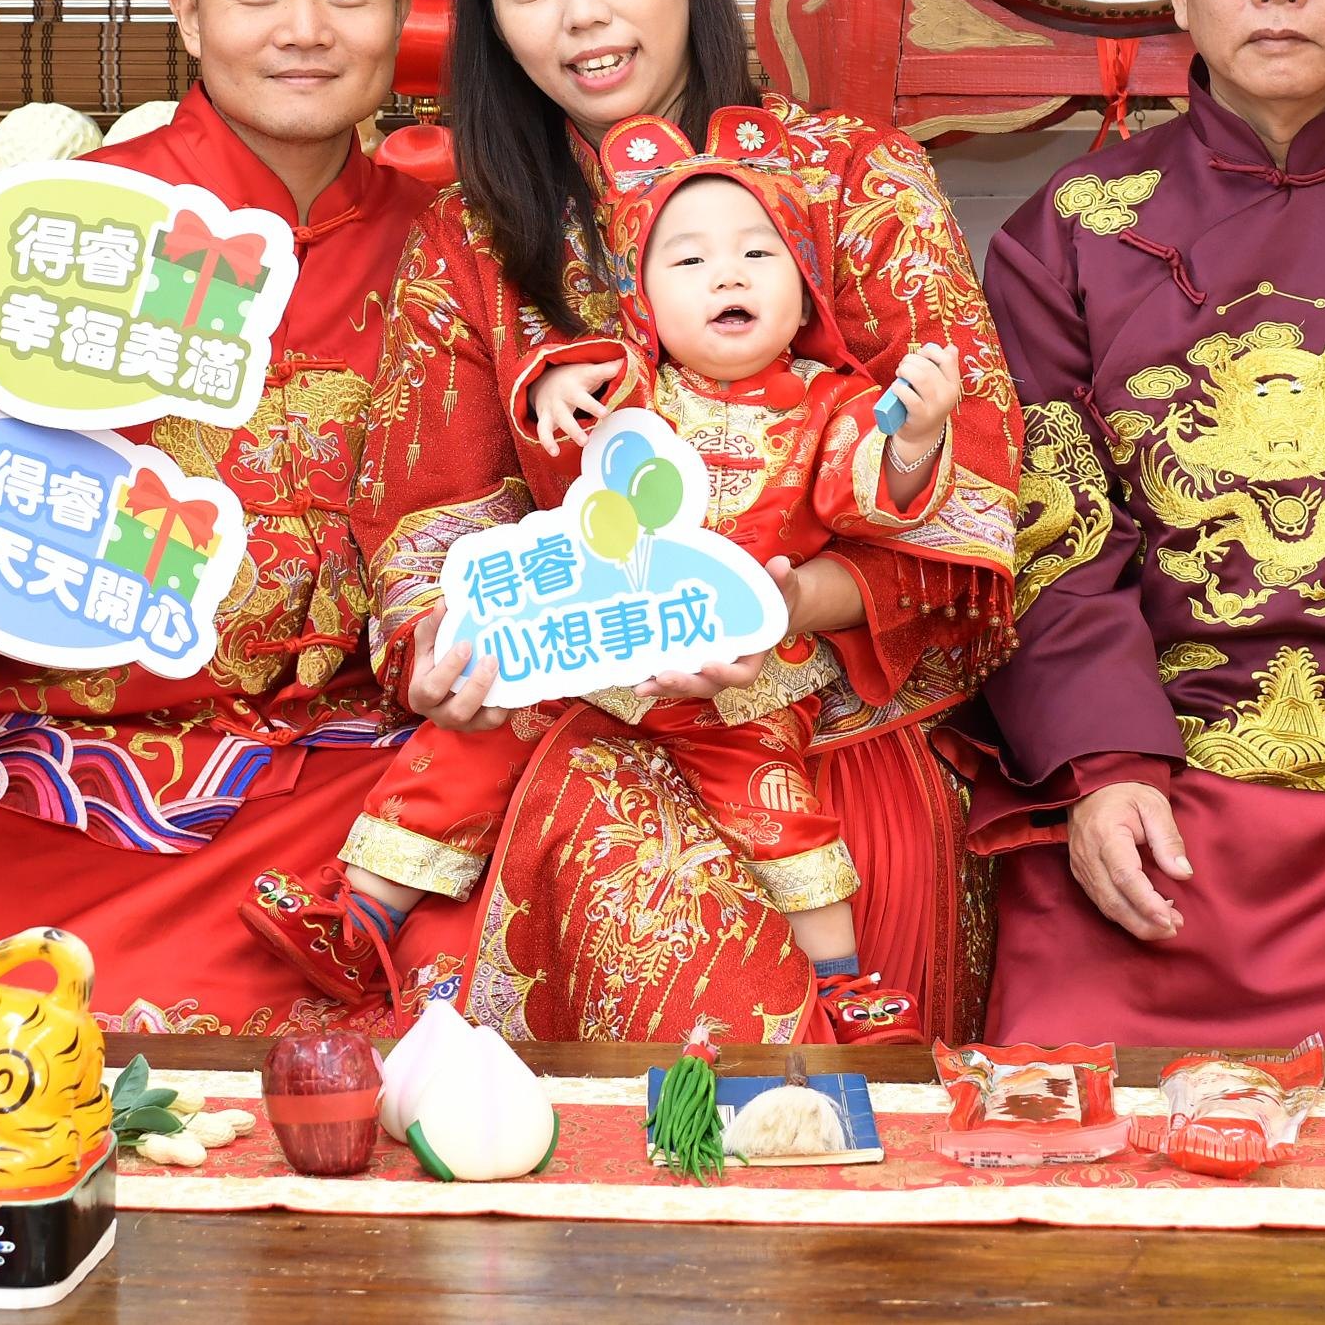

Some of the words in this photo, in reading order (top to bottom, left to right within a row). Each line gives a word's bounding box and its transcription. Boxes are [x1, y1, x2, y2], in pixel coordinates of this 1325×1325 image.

[13, 214, 140, 287] 得睿
[463, 532, 578, 617] 得睿
[484, 586, 716, 682] 心想事成
